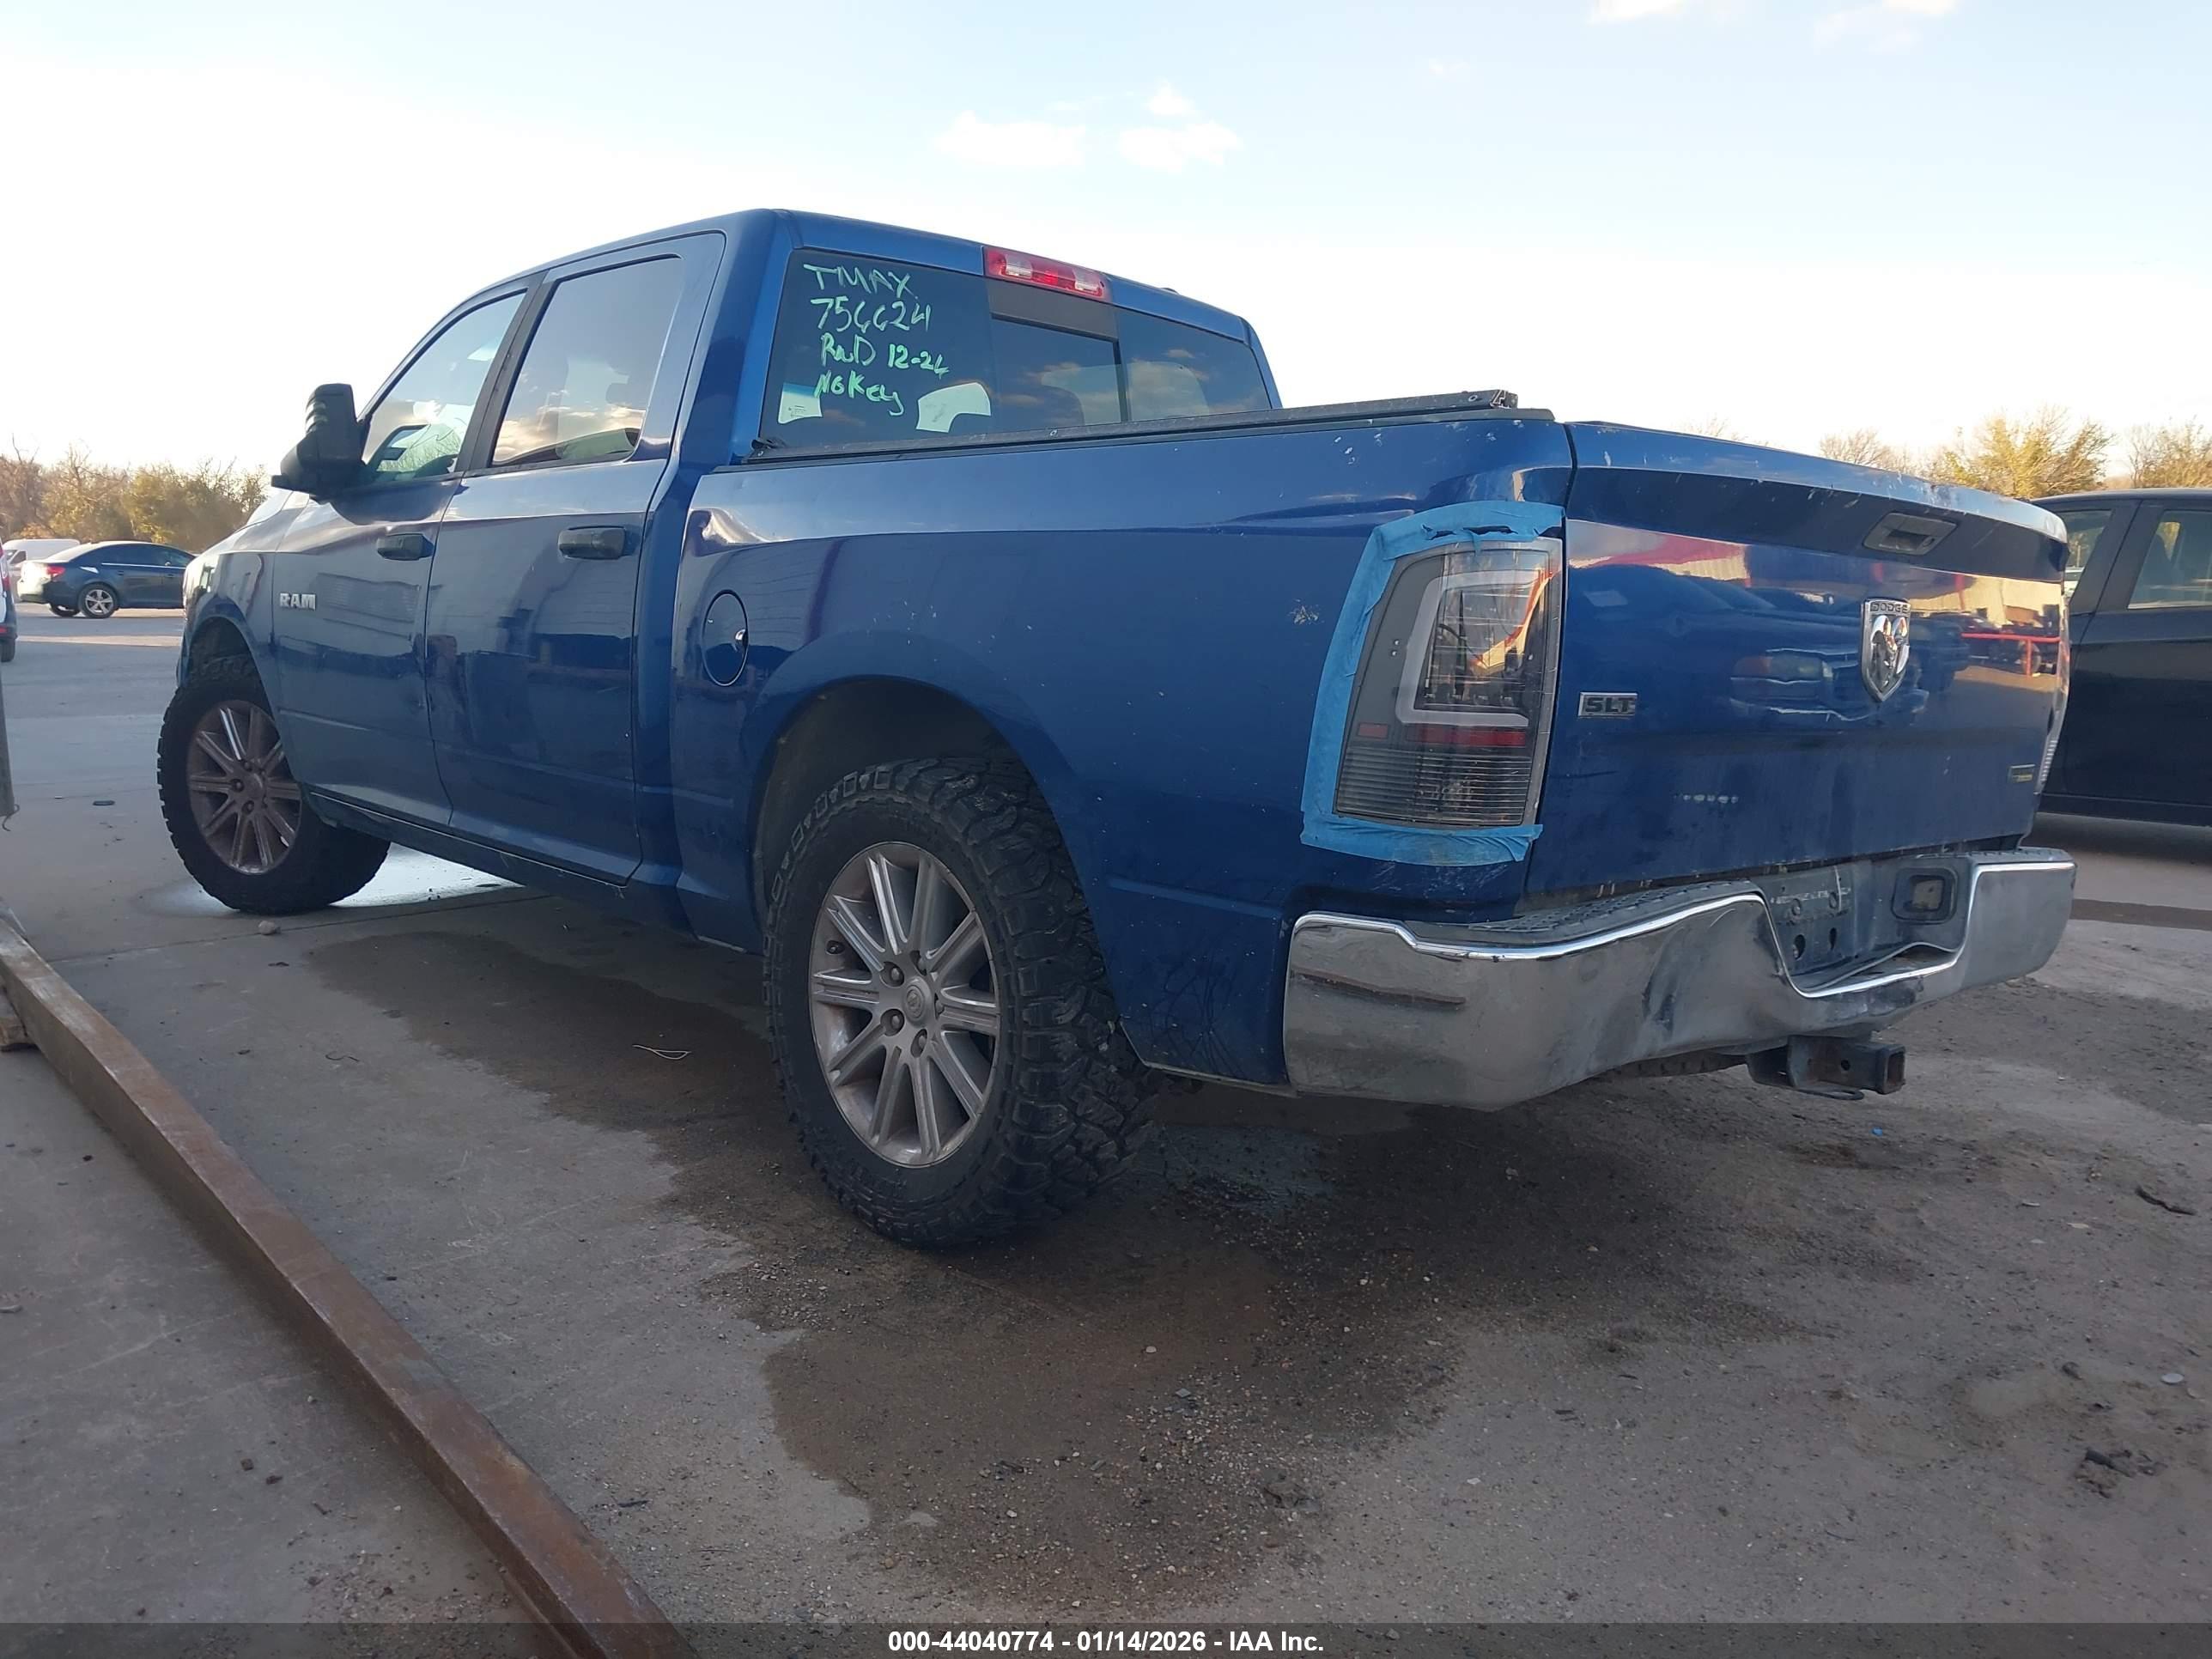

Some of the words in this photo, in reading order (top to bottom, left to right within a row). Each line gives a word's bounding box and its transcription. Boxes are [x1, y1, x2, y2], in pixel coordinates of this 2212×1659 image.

[803, 263, 917, 299] TMAX
[279, 592, 316, 611] RAM
[1870, 602, 1910, 614] DODGE
[1585, 697, 1635, 713] SLT
